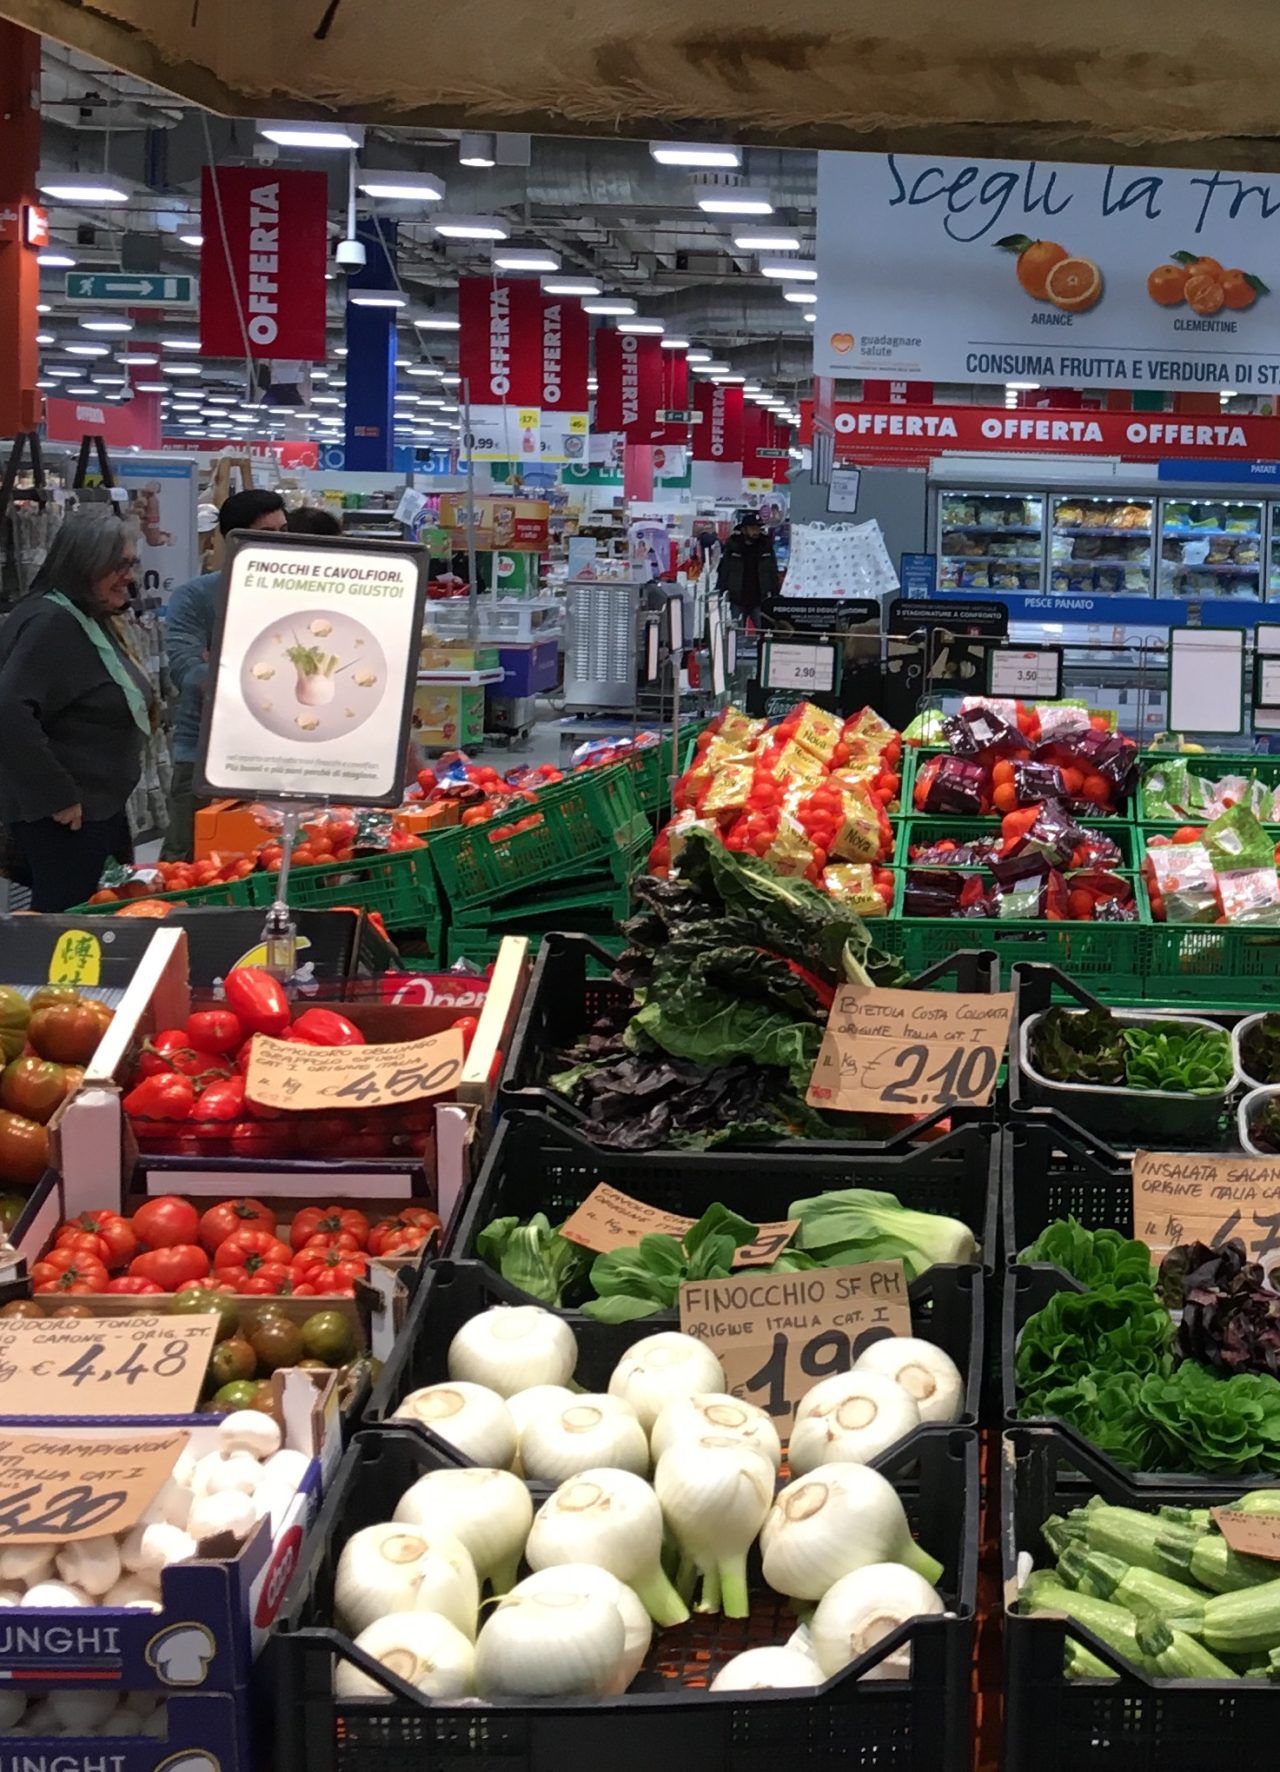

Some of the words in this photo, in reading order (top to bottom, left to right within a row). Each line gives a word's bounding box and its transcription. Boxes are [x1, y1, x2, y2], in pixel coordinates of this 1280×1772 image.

[1102, 166, 1161, 217] la
[248, 183, 280, 345] OFFERTA
[1032, 313, 1073, 326] ARANCE
[1174, 318, 1237, 333] CLEMENTINE
[490, 286, 510, 396] OFFERTA
[861, 335, 921, 347] guadagnare
[543, 304, 562, 403] OFFERTA
[861, 347, 892, 357] salute
[966, 354, 1054, 376] CONSUMA
[1061, 357, 1127, 378] FRUTTA
[1132, 359, 1143, 378] E
[1148, 360, 1231, 381] VERDURA
[1236, 364, 1252, 383] DI
[621, 336, 638, 424] OFFERTA
[711, 387, 725, 456] OFFERTA
[834, 413, 958, 438] OFFERTA
[981, 419, 1103, 442] OFFERTA
[1127, 423, 1247, 447] OFFERTA
[1251, 464, 1277, 475] PATATE
[247, 561, 310, 576] FINOCCHI
[312, 566, 321, 577] E
[323, 567, 404, 583] CAVOLFIORI.
[256, 578, 269, 589] IL
[272, 578, 344, 595] MOMENTO
[348, 583, 404, 598] GIUSTO!
[1024, 598, 1052, 609] PESCE
[1054, 599, 1094, 610] PANATO
[845, 827, 872, 851] Nova
[838, 1024, 893, 1038] ORIGINE
[259, 1039, 352, 1057] POMODORO
[375, 1057, 422, 1069] ITALIA
[840, 1053, 858, 1076] Kg
[861, 1047, 897, 1090] €
[336, 1059, 459, 1103] 4,50
[1141, 1162, 1218, 1182] INSALATA
[1142, 1180, 1203, 1197] ORIGINE
[1210, 1186, 1258, 1200] ITALIA
[686, 1281, 825, 1313] FINOCCHIO
[835, 1277, 861, 1299] SF
[95, 1318, 159, 1329] TONDO
[688, 1321, 753, 1338] ORIGINE
[767, 1315, 822, 1330] ITALIA
[871, 1306, 890, 1322] I
[32, 1333, 106, 1344] CAMONE
[31, 1360, 55, 1376] €
[57, 1339, 189, 1387] 4,48
[22, 1438, 179, 1457] CHAMPIGNON
